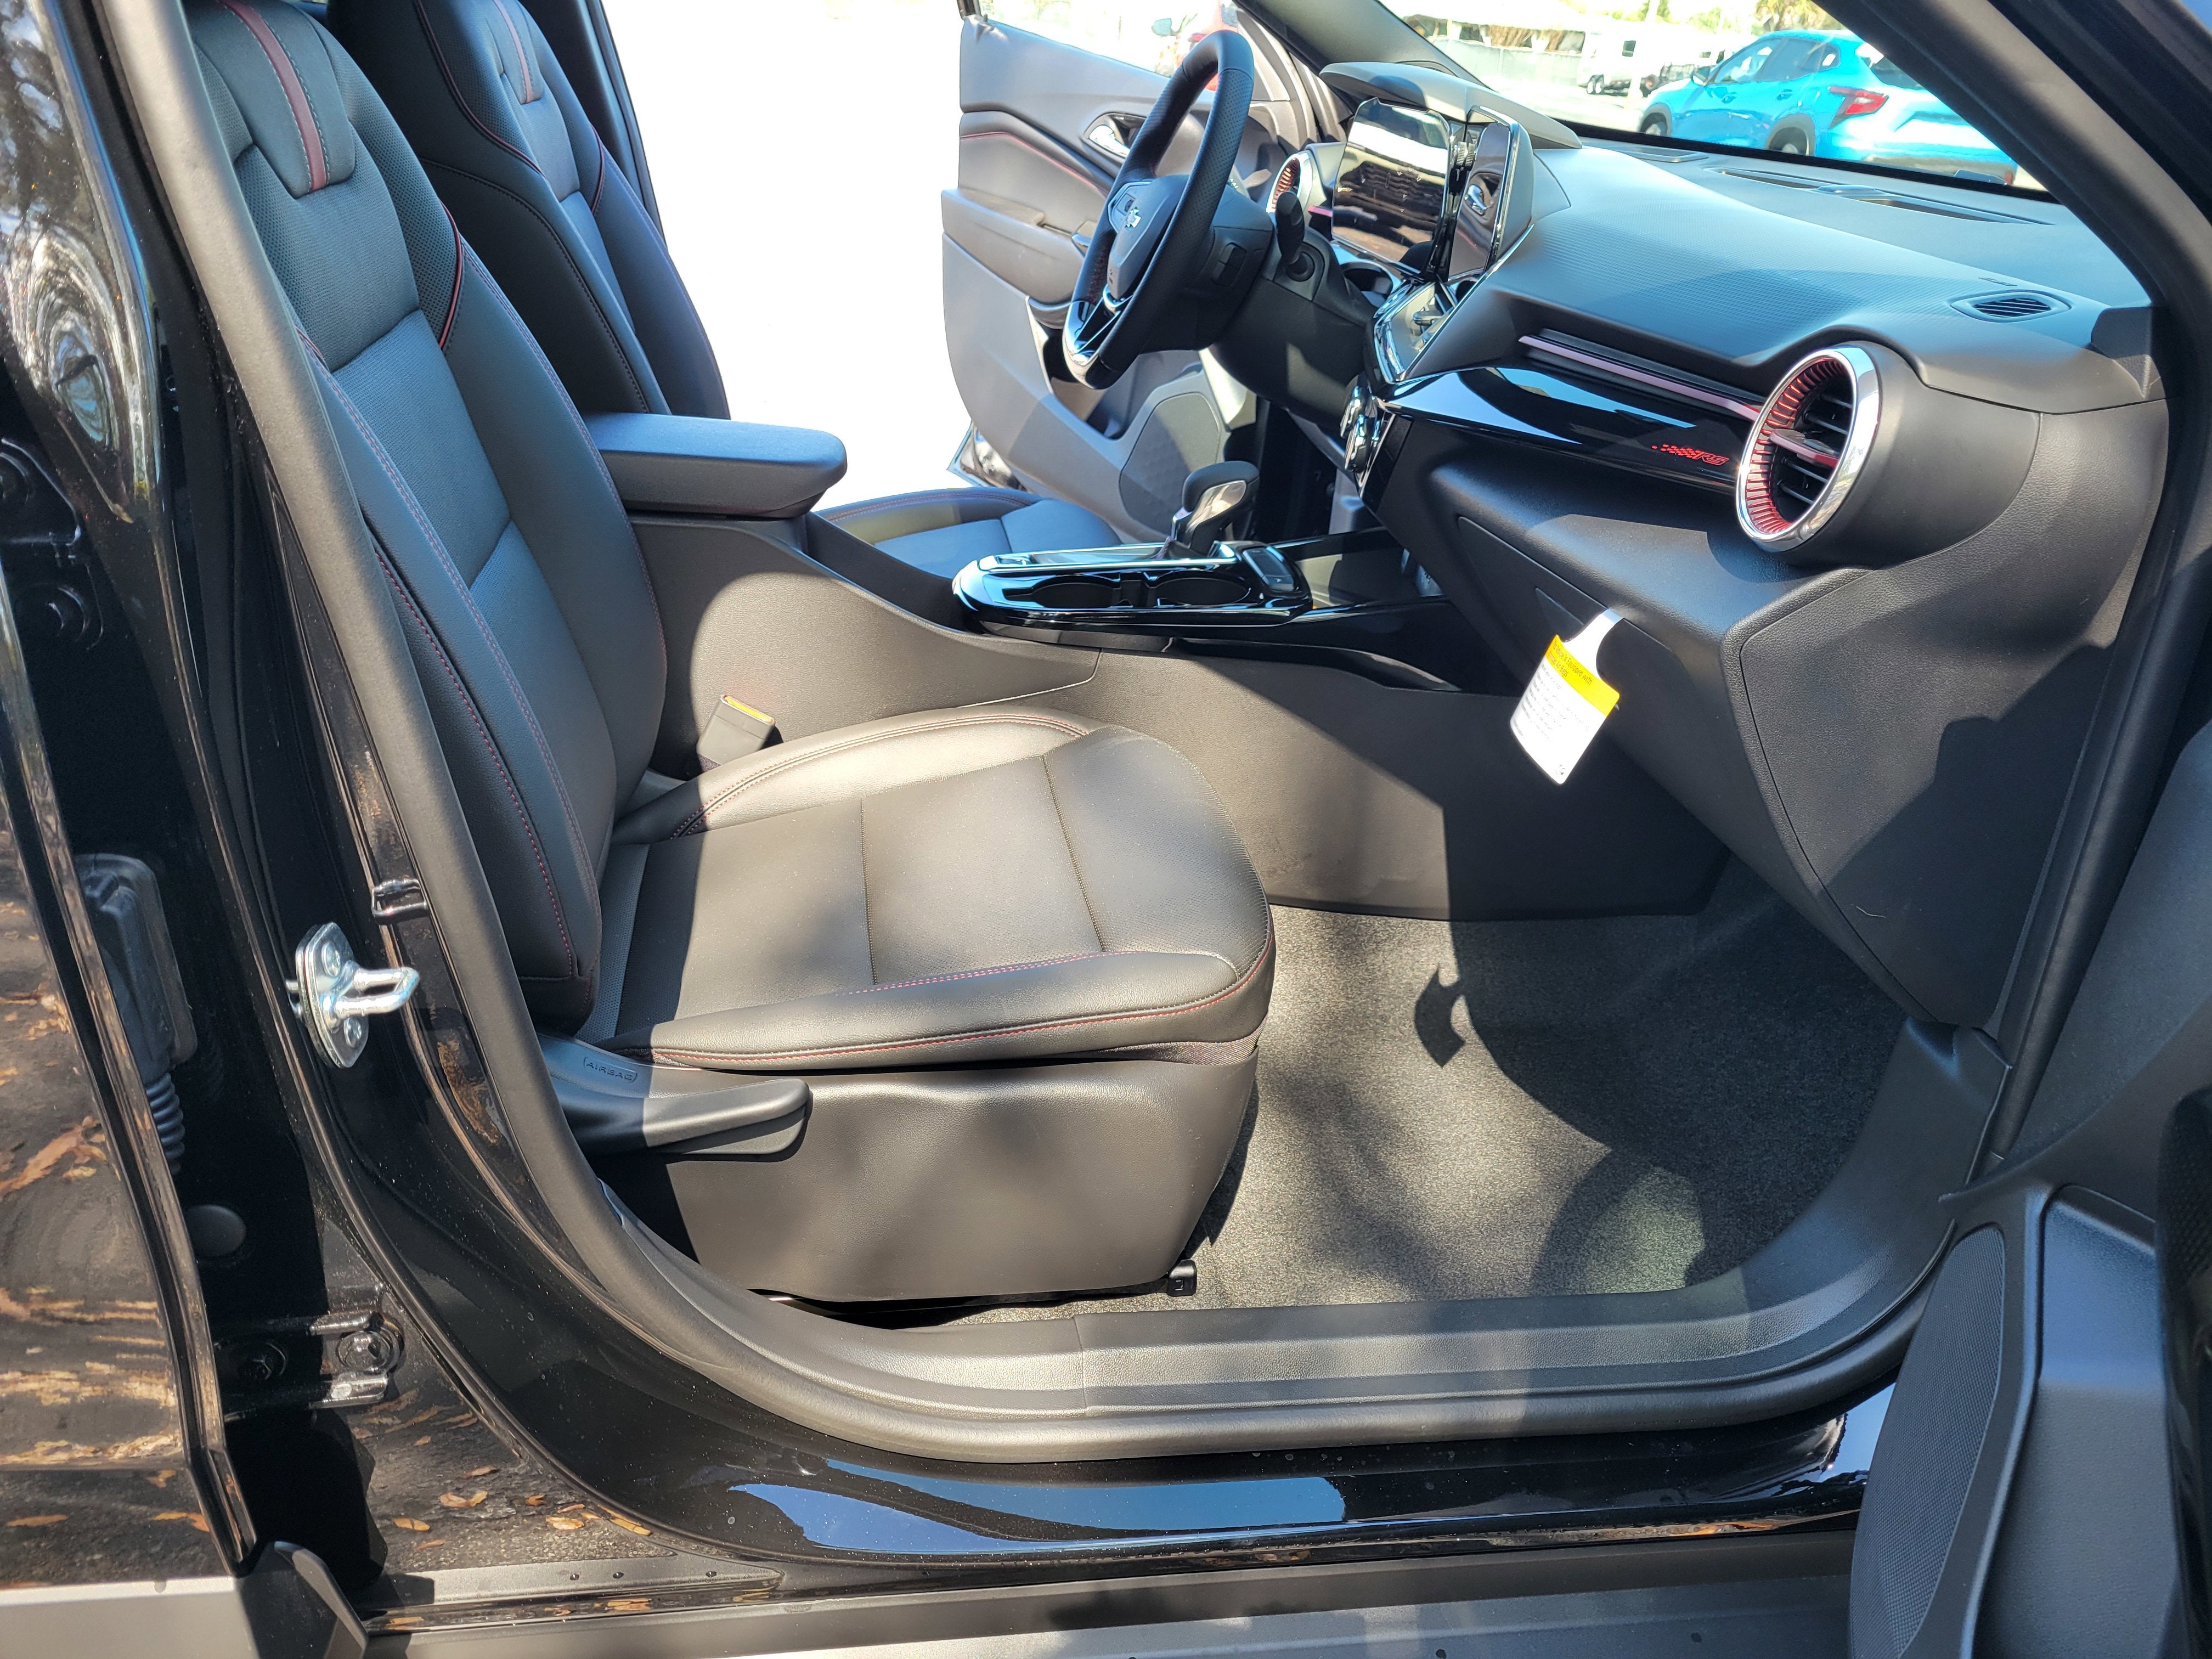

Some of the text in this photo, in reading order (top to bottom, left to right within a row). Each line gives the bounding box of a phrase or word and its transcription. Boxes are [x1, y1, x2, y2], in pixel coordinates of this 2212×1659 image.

[1691, 452, 1730, 466] RS
[1582, 674, 1593, 685] with
[585, 1062, 633, 1081] AIRBAG
